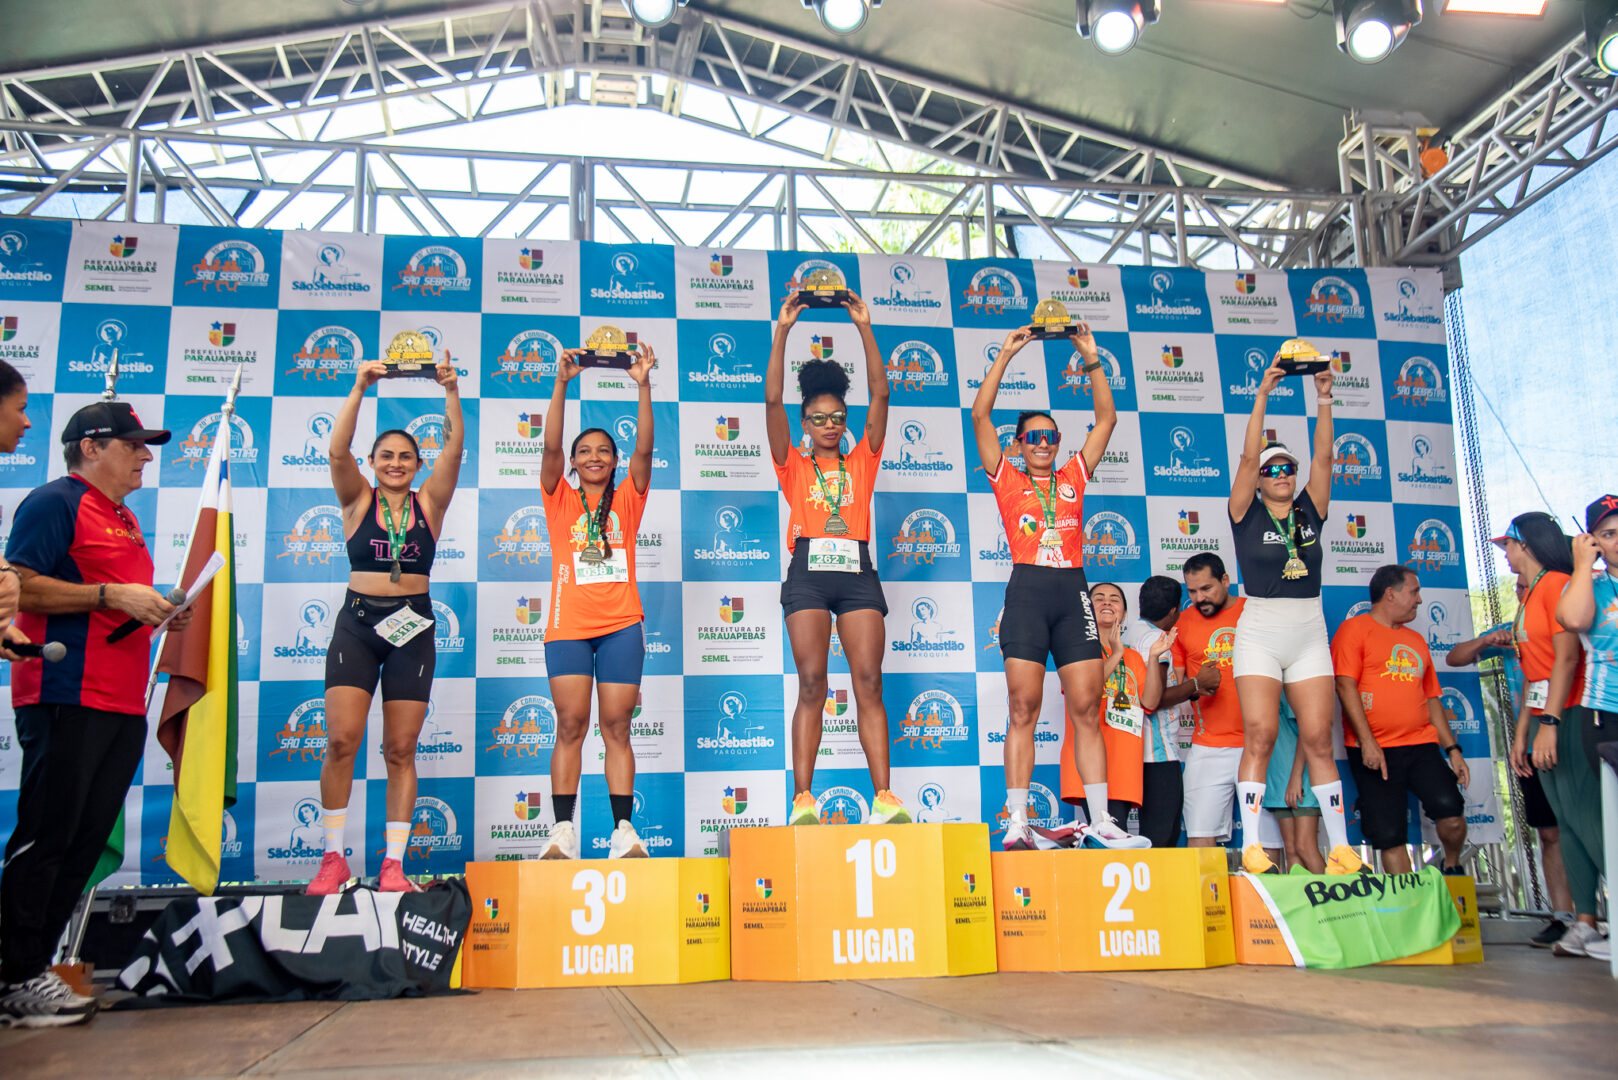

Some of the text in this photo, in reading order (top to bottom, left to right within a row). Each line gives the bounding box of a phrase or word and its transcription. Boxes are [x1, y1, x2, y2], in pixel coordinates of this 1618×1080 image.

[84, 264, 157, 272] PARAUAPEBAS
[498, 275, 564, 285] PARAUAPEBAS
[690, 282, 754, 291] PARAUAPEBAS
[184, 354, 256, 363] PARAUAPEBAS
[1146, 375, 1204, 383] PARAUAPEBAS
[916, 543, 960, 553] SEBASTIÃO
[1099, 545, 1141, 554] SEBASTIÃO
[1331, 545, 1385, 554] PARAUAPEBAS
[816, 555, 839, 564] 262
[892, 640, 965, 651] SãoSebastião
[924, 725, 969, 736] SEBASTIÃO
[697, 736, 774, 749] SãoSebastião
[495, 854, 525, 862] SEMEL
[402, 911, 458, 948] HEALTH
[833, 928, 915, 964] LUGAR
[1100, 930, 1160, 957] LUGAR
[563, 944, 634, 975] LUGAR
